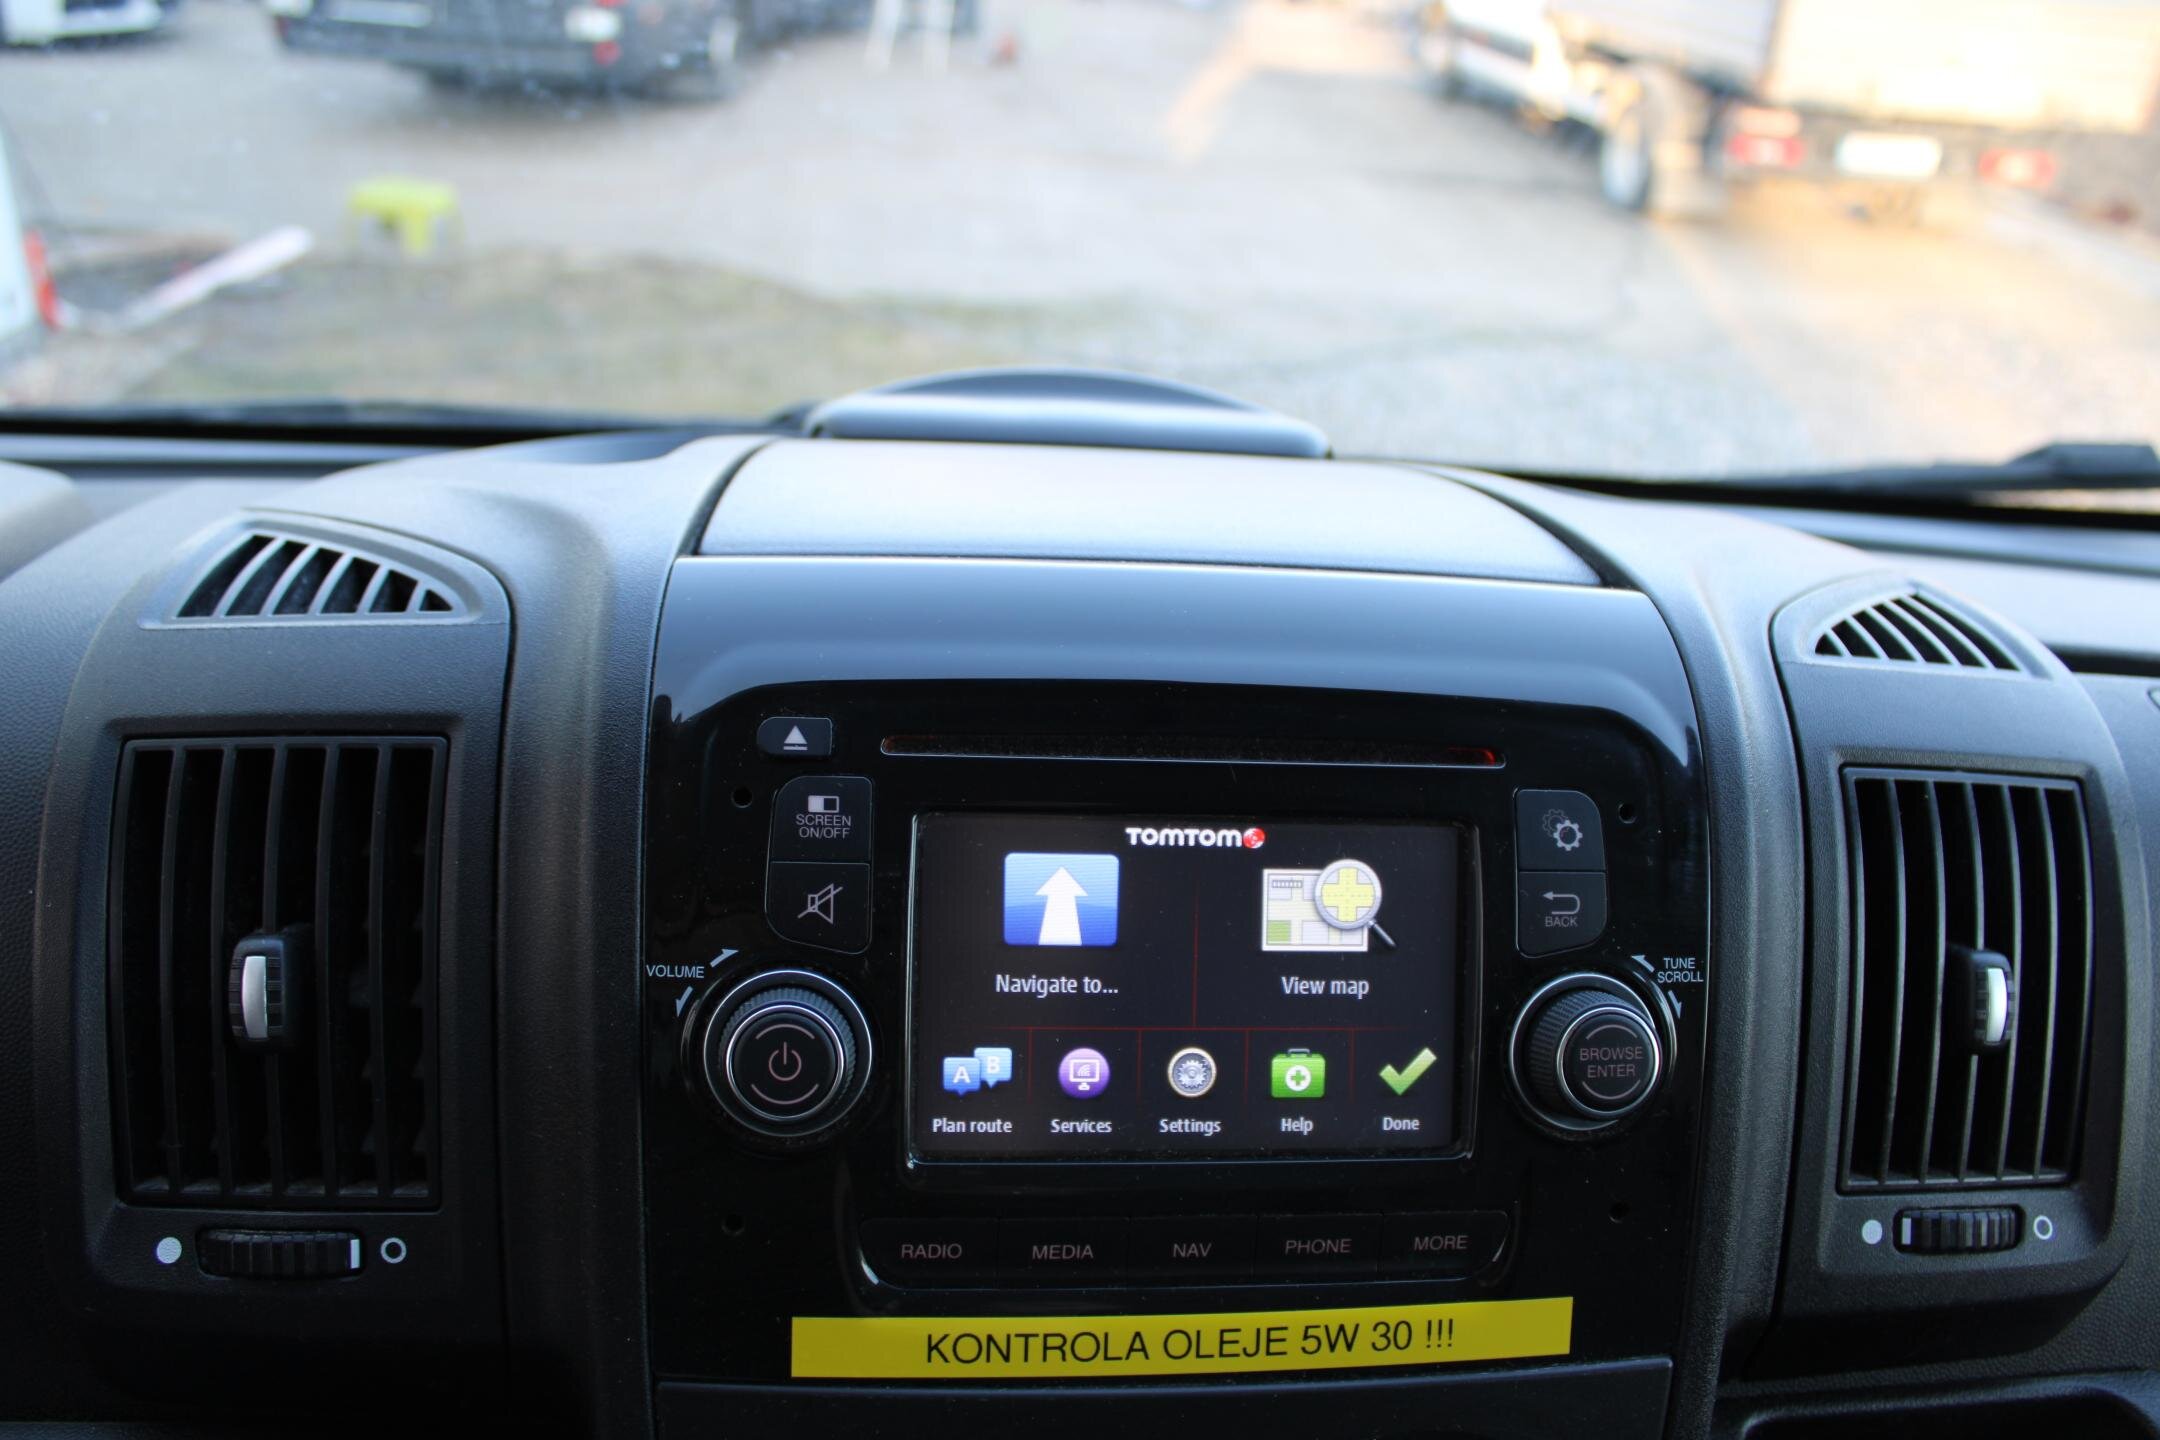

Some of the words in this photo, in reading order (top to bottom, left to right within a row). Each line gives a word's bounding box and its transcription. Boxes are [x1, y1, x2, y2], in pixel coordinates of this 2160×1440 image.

[796, 814, 851, 826] SCREEN
[799, 826, 850, 838] ON/OFF
[1545, 916, 1578, 928] BACK
[1663, 957, 1696, 970] TUNE
[646, 965, 704, 978] VOLUME
[1658, 970, 1704, 983] SCROLL
[996, 974, 1077, 997] Navigate
[1083, 977, 1118, 993] to...
[1282, 977, 1325, 994] View
[1330, 981, 1369, 999] map
[1580, 1047, 1643, 1061] BROWSE
[987, 1056, 1000, 1073] B
[1587, 1063, 1636, 1078] ENTER
[952, 1066, 971, 1083] A
[933, 1118, 966, 1132] Plan
[970, 1119, 1012, 1132] route
[1051, 1119, 1112, 1132] Services
[1160, 1119, 1221, 1136] Settings
[1281, 1117, 1313, 1135] Help
[1383, 1117, 1419, 1130] Done
[1285, 1239, 1351, 1254] PHONE
[1414, 1235, 1468, 1250] MORE
[902, 1244, 962, 1258] RADIO
[1033, 1245, 1093, 1259] MEDIA
[1173, 1243, 1211, 1257] NAV
[927, 1331, 1149, 1364] KONTROLA
[1163, 1327, 1288, 1360] OLEJE
[1301, 1323, 1359, 1355] 5W
[1371, 1321, 1412, 1352] 30
[1426, 1319, 1453, 1348] !!!
